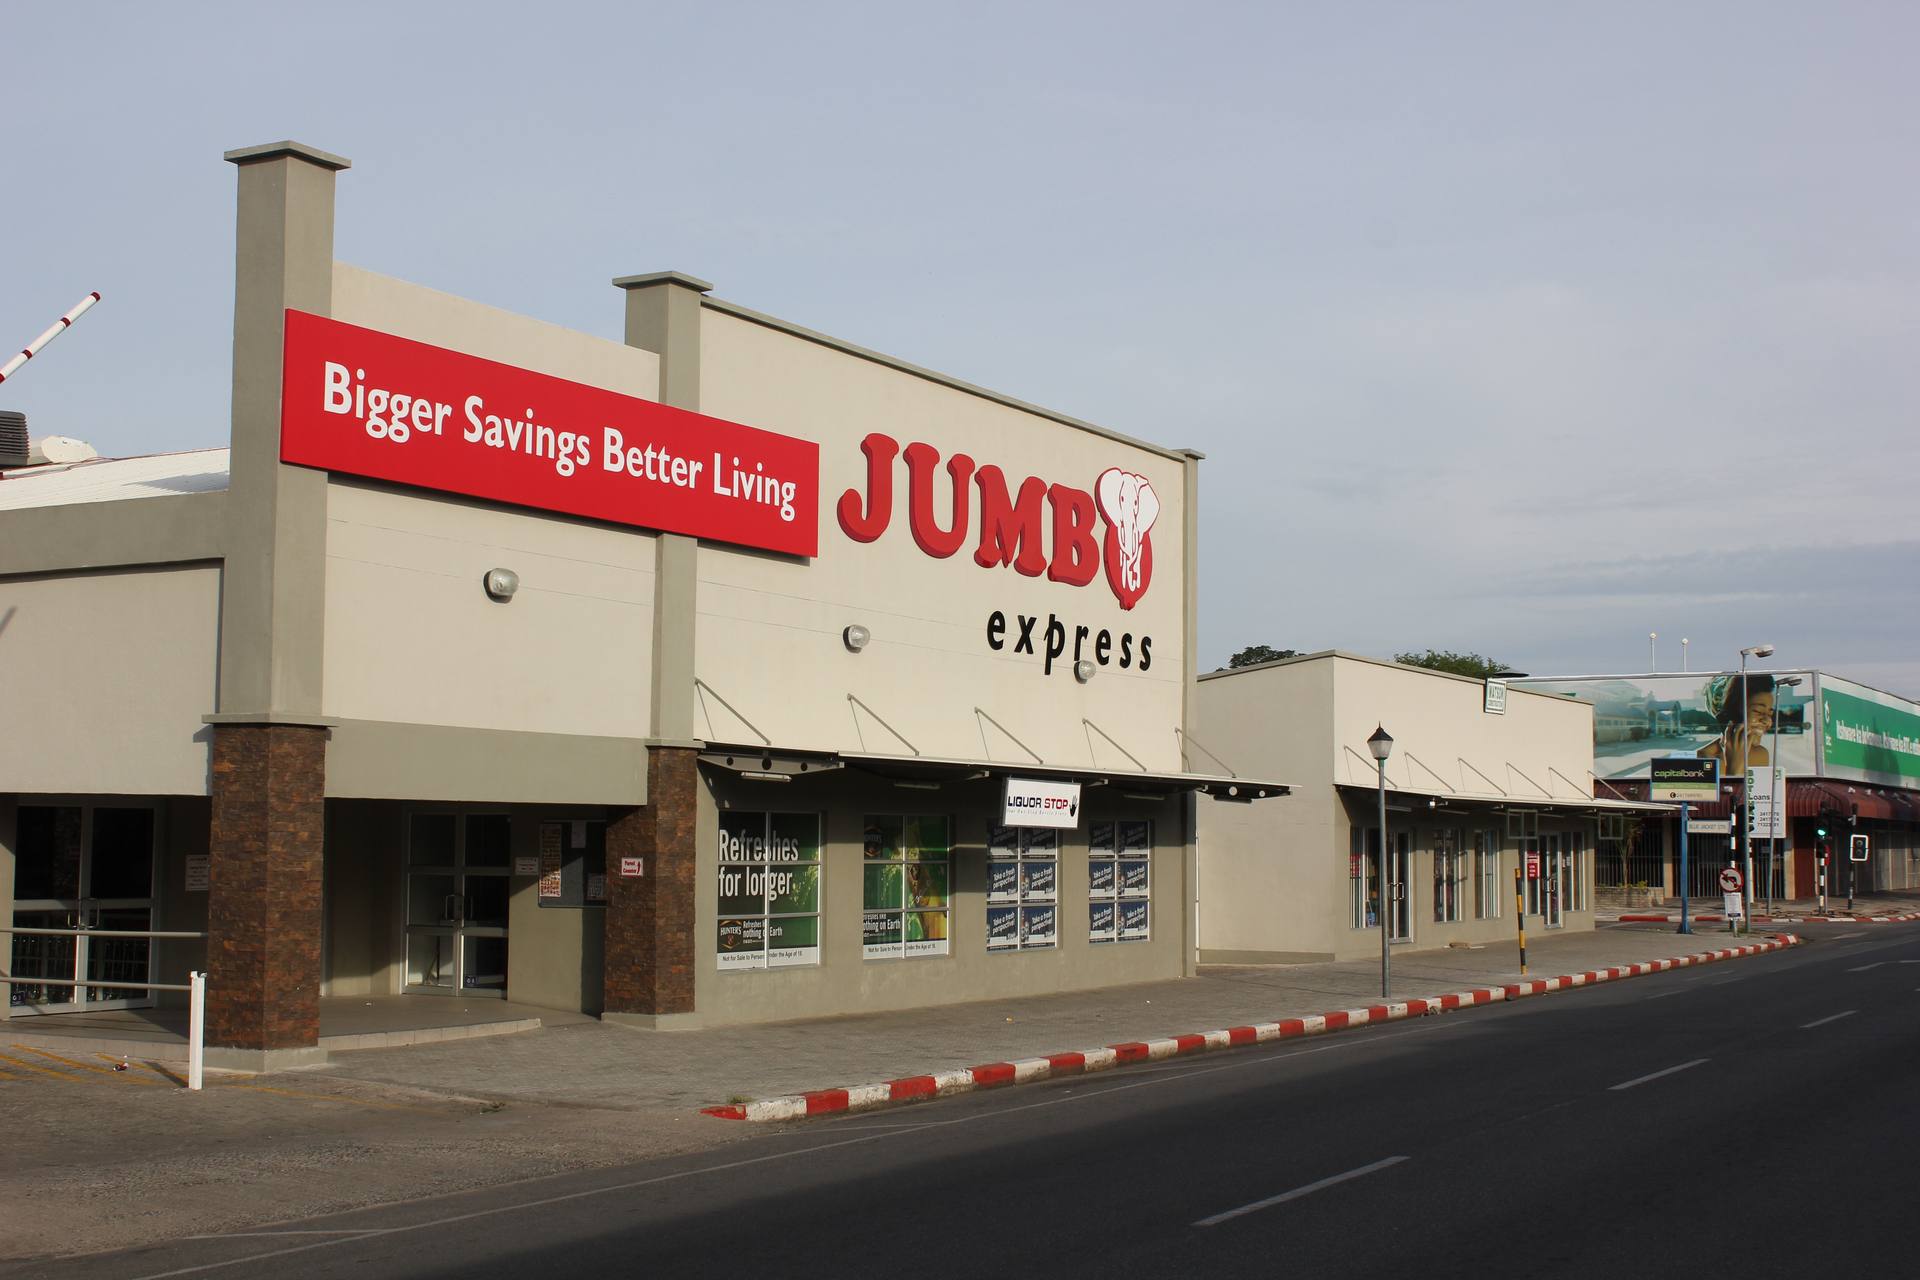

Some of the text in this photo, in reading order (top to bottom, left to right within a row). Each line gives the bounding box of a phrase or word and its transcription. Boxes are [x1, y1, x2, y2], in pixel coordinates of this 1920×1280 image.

[323, 361, 797, 522] Bigger Savings Better Living
[986, 610, 1153, 676] express
[1008, 796, 1068, 810] LIQUOR STOP
[719, 829, 799, 861] Refreshes
[719, 866, 793, 901] for longer
[770, 926, 783, 936] Earth
